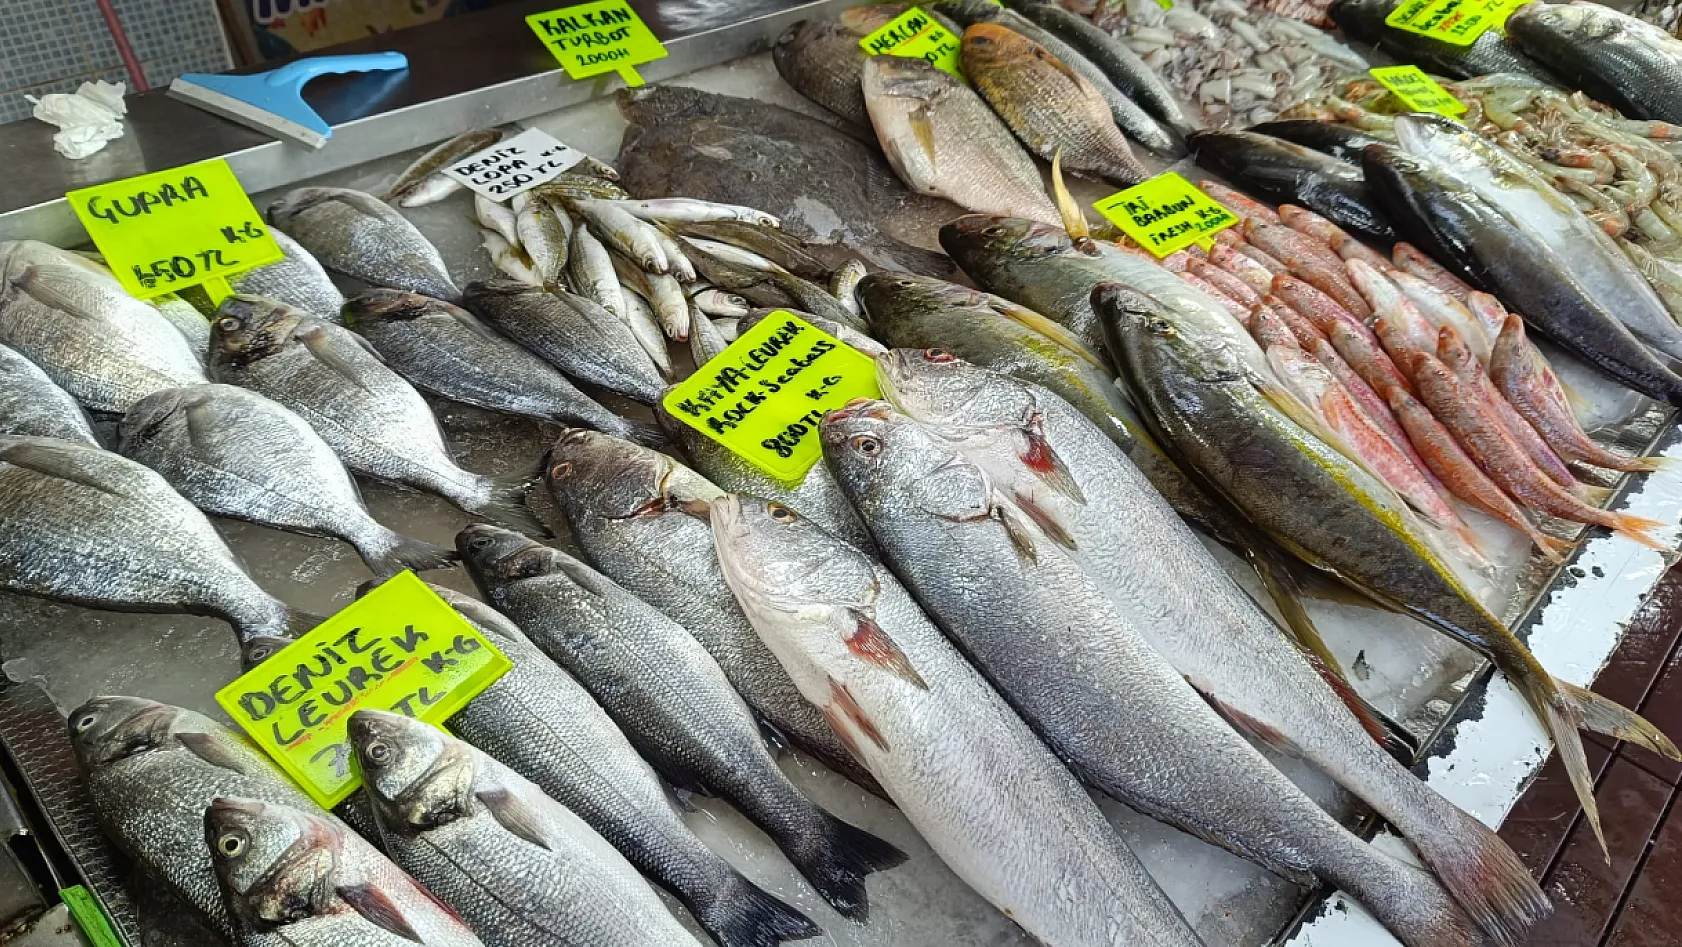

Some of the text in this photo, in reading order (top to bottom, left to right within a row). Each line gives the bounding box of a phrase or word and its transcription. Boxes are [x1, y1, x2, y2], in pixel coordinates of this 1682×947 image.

[538, 8, 631, 36] KALKAN
[551, 26, 631, 51] TURBOT
[471, 159, 528, 185] LOPA
